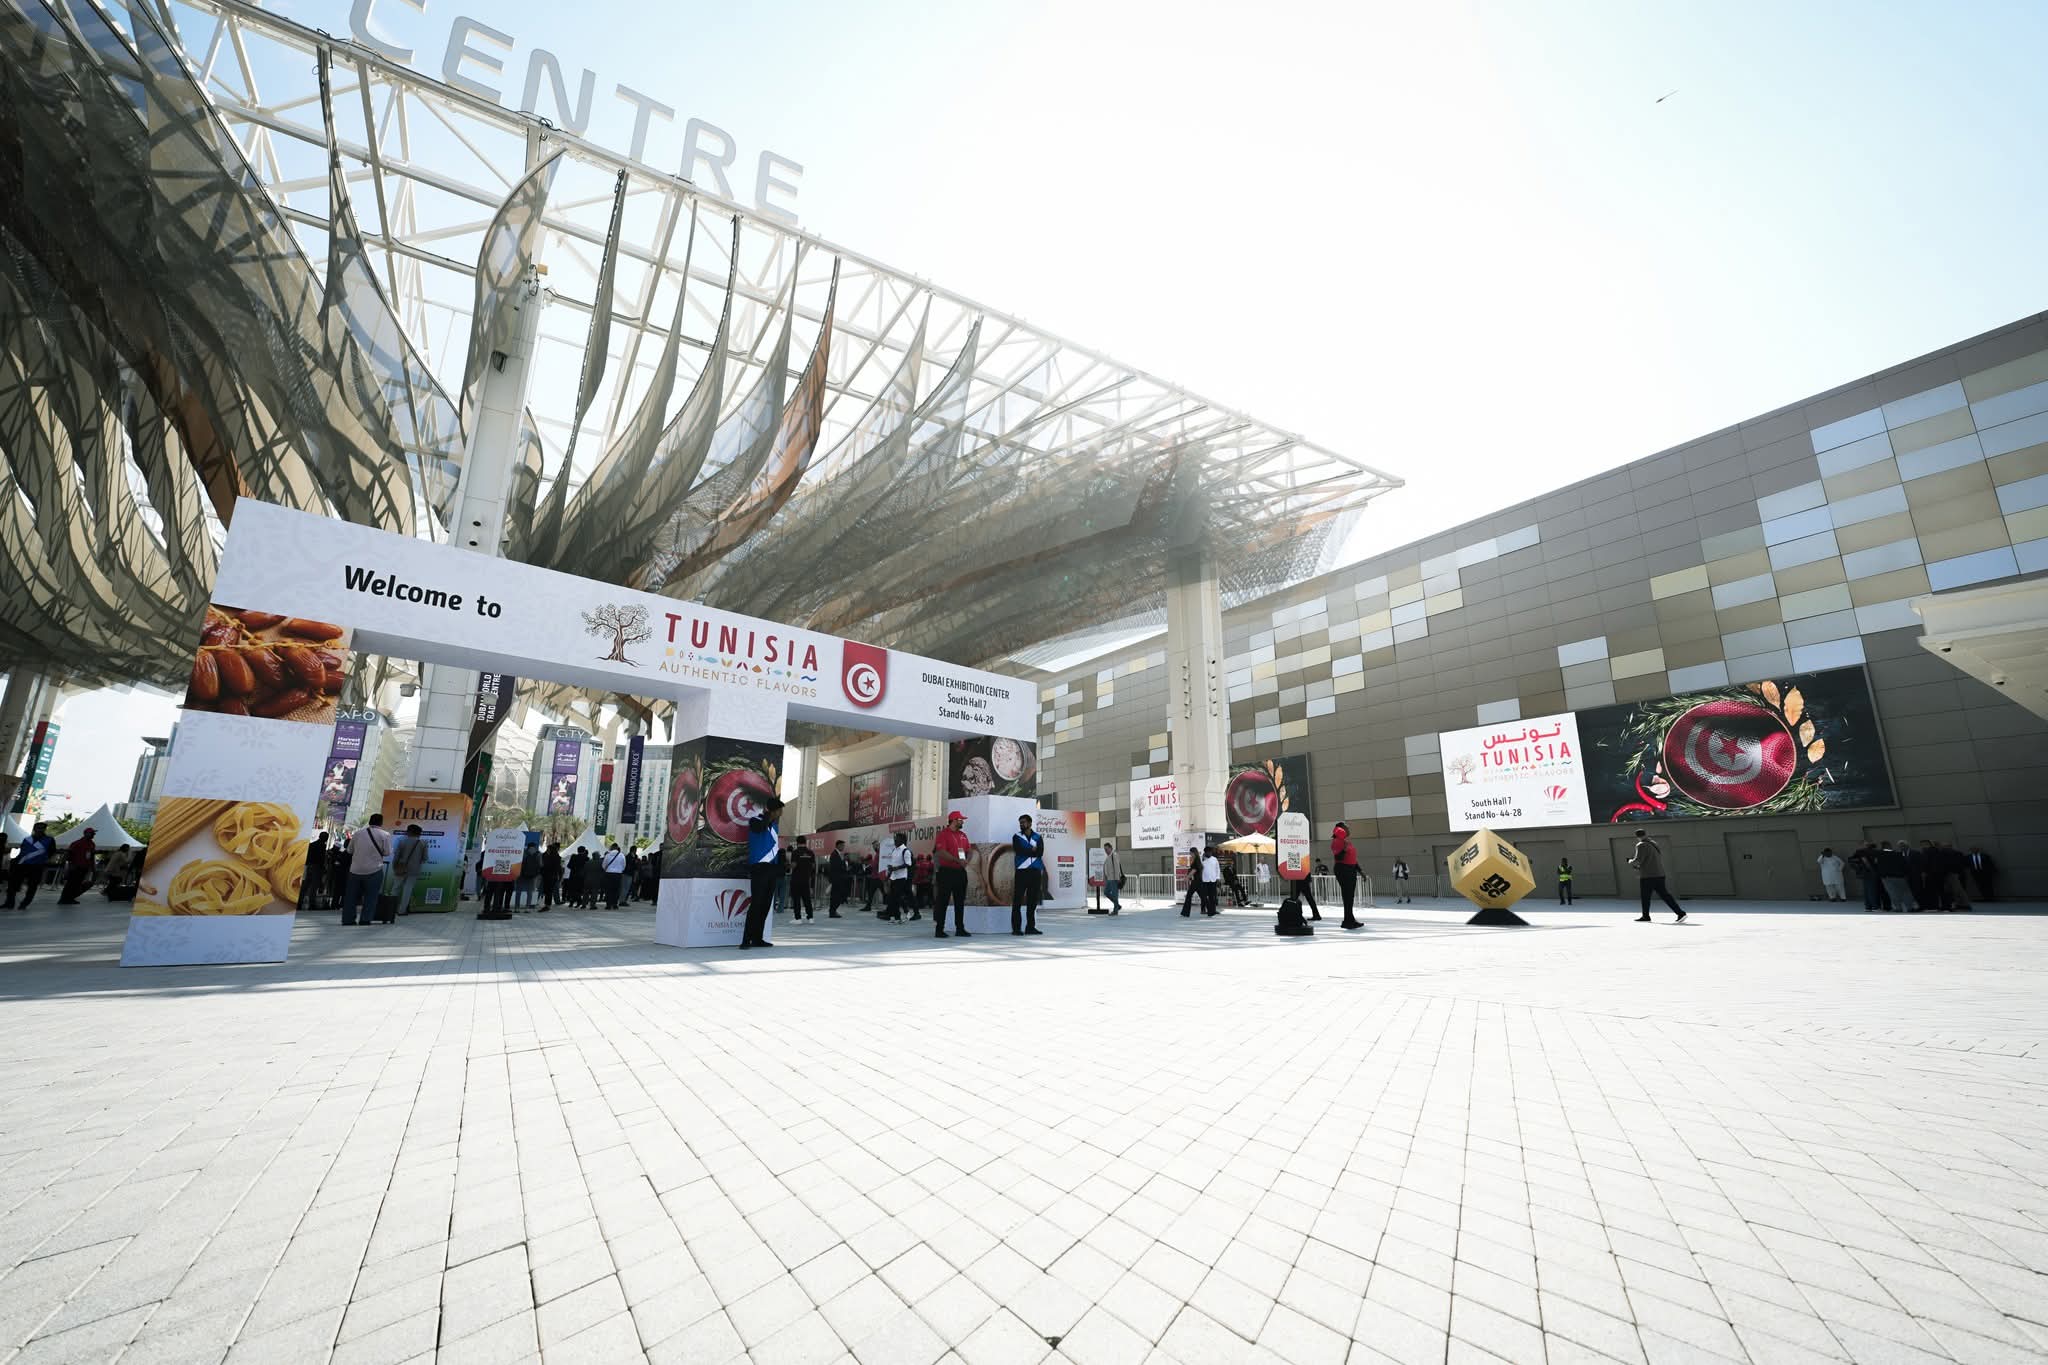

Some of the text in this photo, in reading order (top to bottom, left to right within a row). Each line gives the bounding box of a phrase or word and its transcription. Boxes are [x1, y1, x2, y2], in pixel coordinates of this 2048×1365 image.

[349, 0, 805, 226] CENTRE
[345, 565, 502, 619] Welcome to
[665, 612, 818, 671] TUNISIA
[481, 674, 492, 695] ORLD
[659, 661, 817, 698] AUTHENTIC FLAVORS
[922, 672, 1010, 700] DUBAI EXHIBITION CENTER
[486, 673, 501, 723] TRAD ENTRE
[947, 693, 987, 709] South Hall 7
[939, 706, 960, 720] Stand
[974, 713, 994, 726] 44-28
[1483, 722, 1561, 749] تونس
[1480, 741, 1571, 768] TUNISIA
[627, 752, 641, 804] MAHMOOD RICE
[398, 799, 449, 821] India
[1465, 811, 1485, 820] Stand
[1500, 808, 1522, 818] 44-28
[1471, 796, 1512, 808] South Hall 7
[914, 826, 934, 841] YOUR
